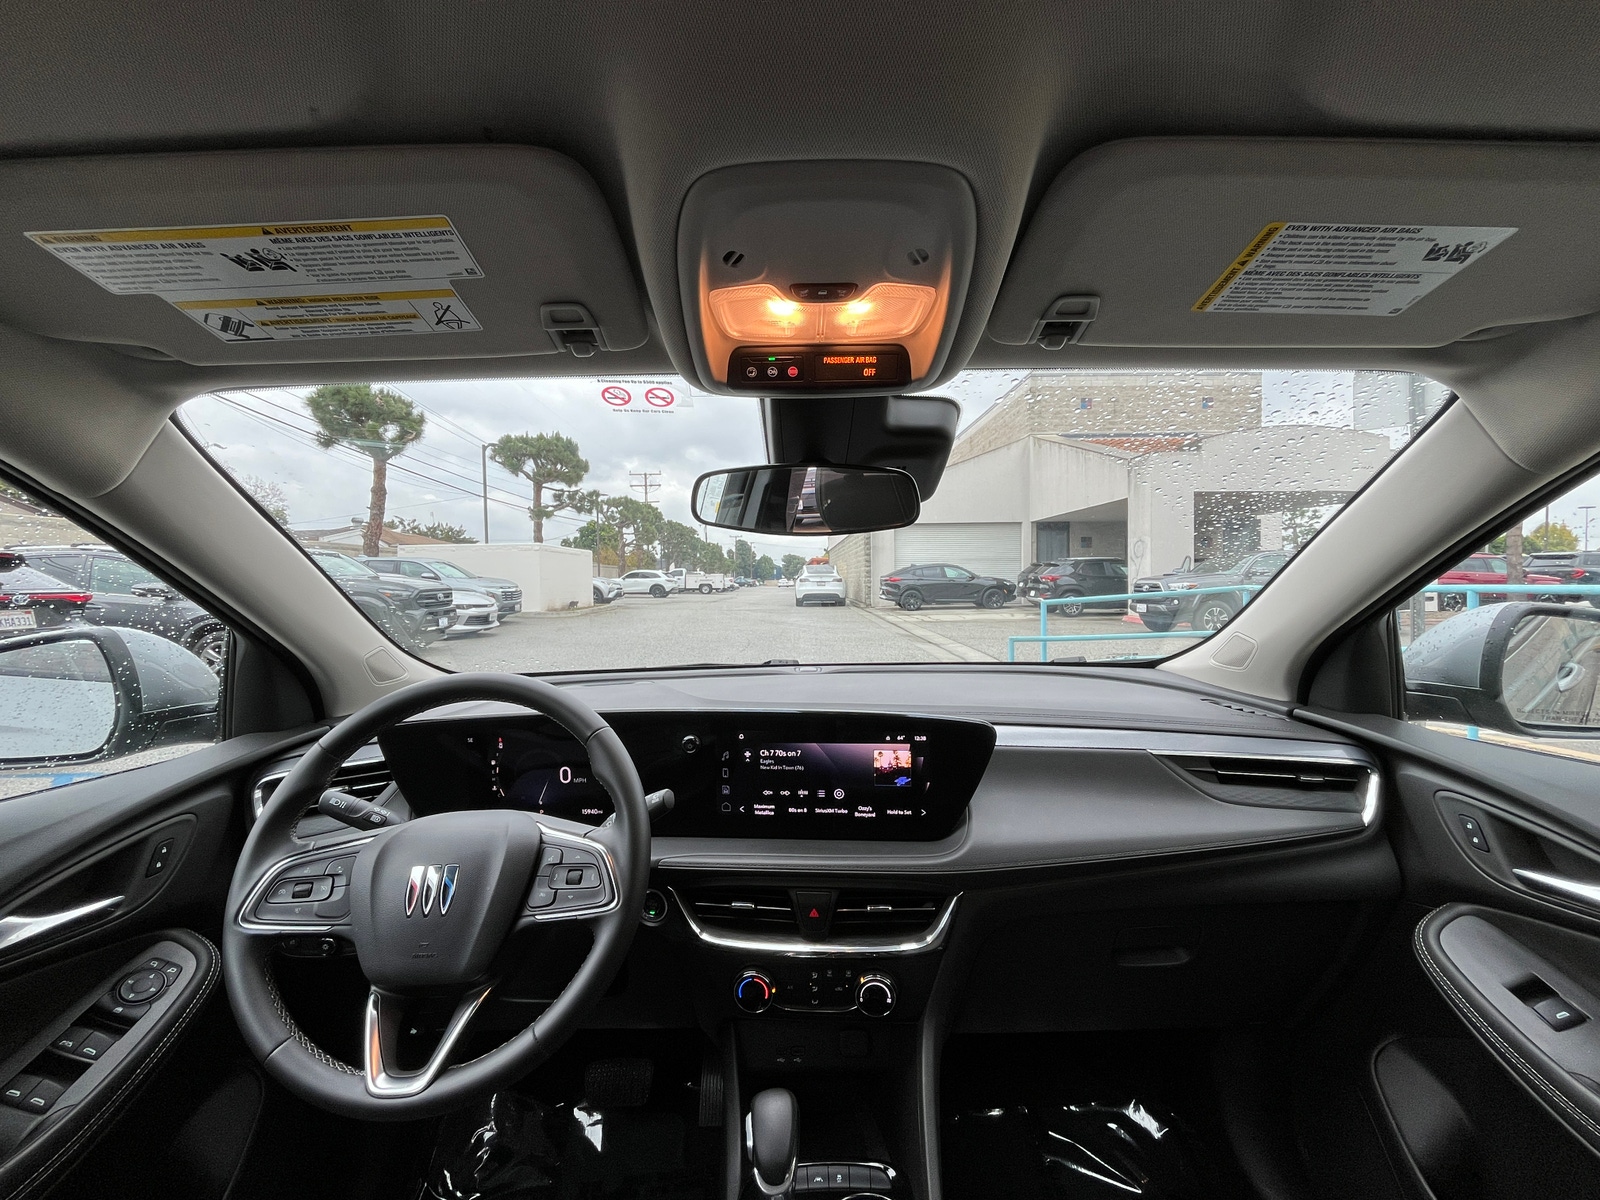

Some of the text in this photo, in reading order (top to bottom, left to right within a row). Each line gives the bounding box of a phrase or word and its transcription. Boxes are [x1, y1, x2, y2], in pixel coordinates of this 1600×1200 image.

[274, 225, 354, 235] AVERTISSEMENT
[354, 232, 402, 240] GONFLABLES
[402, 229, 454, 238] INTELLIGENTS
[54, 234, 103, 243] WARNING
[1244, 227, 1280, 258] WARNING
[108, 243, 159, 251] ADVANCED
[1197, 268, 1240, 310] AVERTISSEMENT
[823, 356, 877, 364] PASSENGER AIR BAG
[863, 368, 876, 376] OFF
[760, 749, 769, 757] Ch
[559, 766, 571, 784] 0
